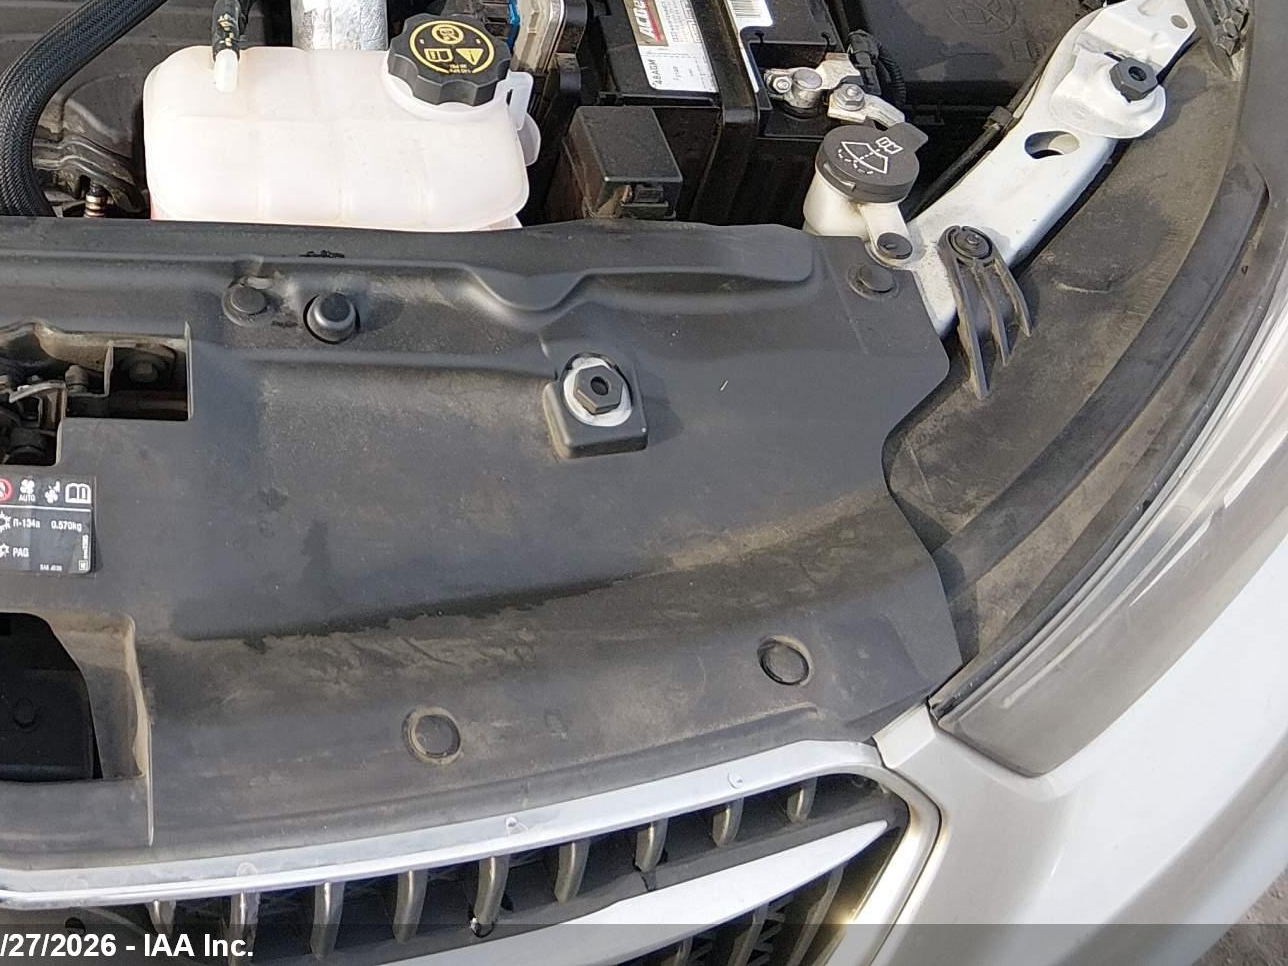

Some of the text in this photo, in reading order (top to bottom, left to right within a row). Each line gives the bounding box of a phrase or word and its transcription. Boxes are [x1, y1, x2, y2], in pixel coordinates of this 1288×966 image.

[18, 494, 36, 502] AUTO
[50, 520, 83, 532] 0.570kg
[12, 547, 30, 558] PAG
